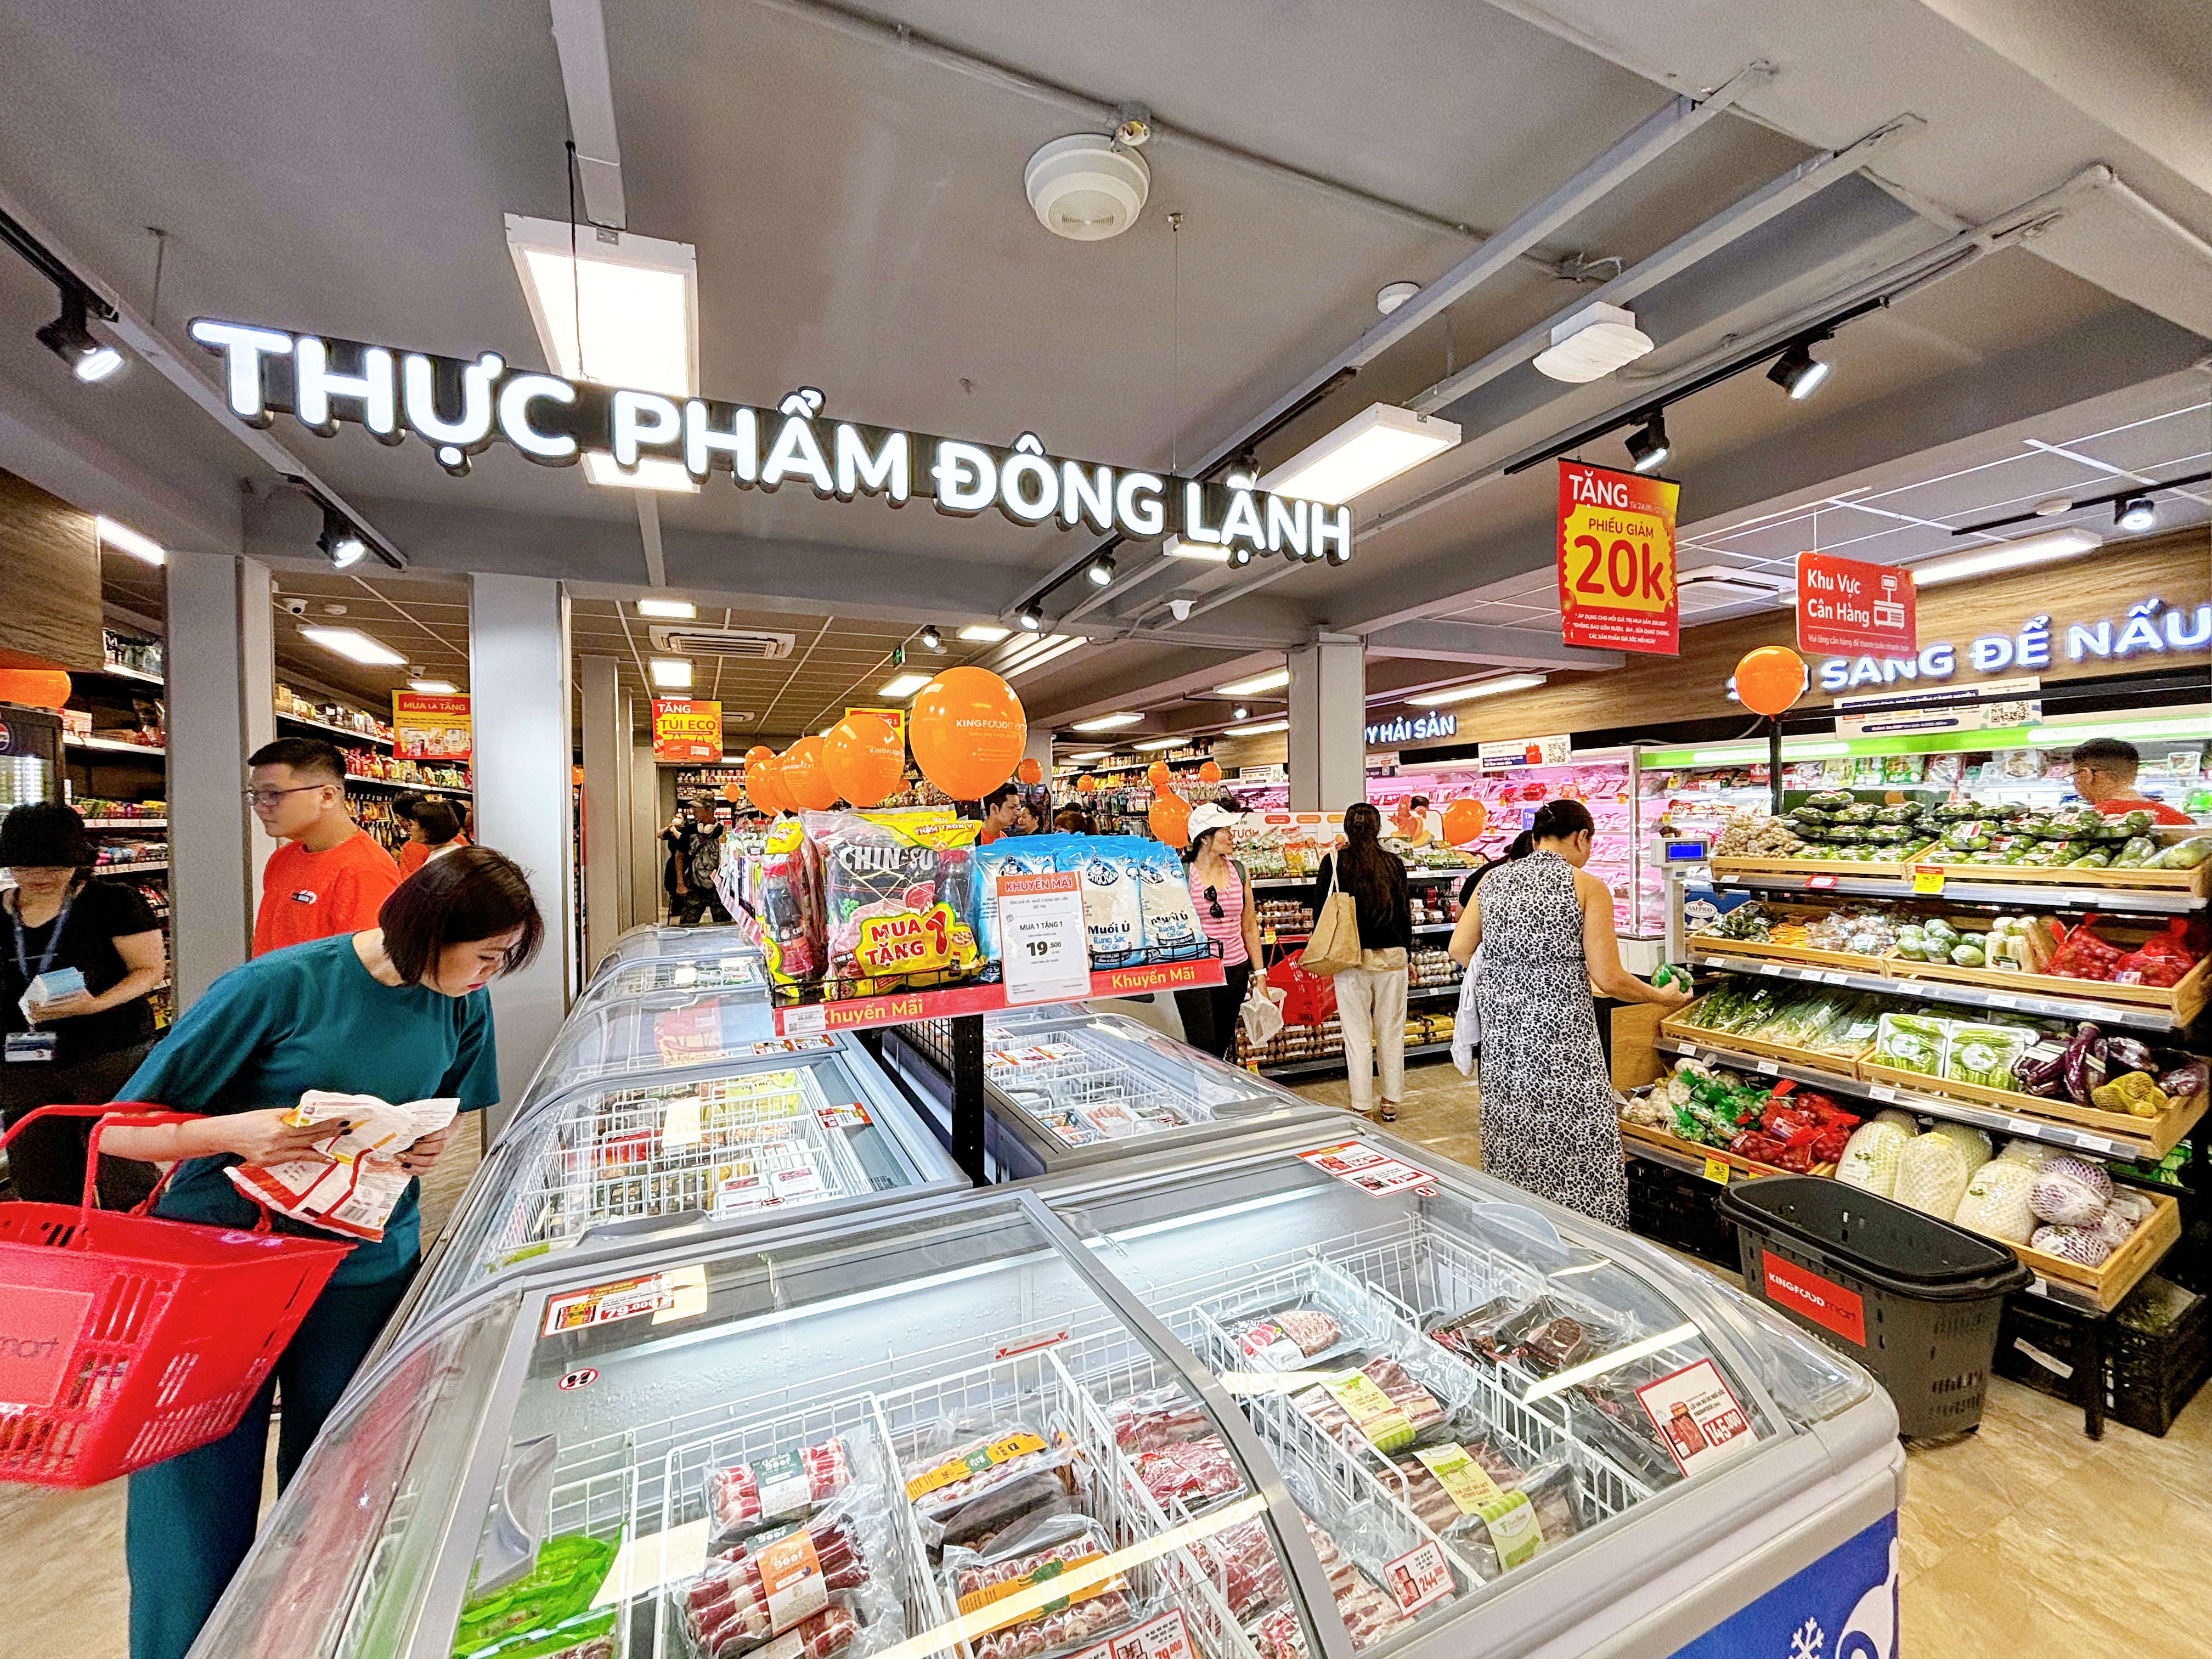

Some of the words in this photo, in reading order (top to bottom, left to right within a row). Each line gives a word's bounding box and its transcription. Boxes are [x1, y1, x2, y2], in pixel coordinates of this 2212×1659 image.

[188, 319, 578, 472] THỰC
[610, 387, 911, 502] PHẨM
[930, 432, 1165, 537] ĐÔNG
[1185, 481, 1351, 565] LẠNH
[1568, 469, 1628, 509] TẶNG
[1589, 516, 1623, 534] PHIẾU
[1627, 522, 1654, 538] GIẢM
[1573, 533, 1666, 601] 20k
[1808, 568, 1834, 591] Khu
[1837, 573, 1861, 598] Vực
[1808, 598, 1833, 619] Cân
[1836, 602, 1870, 628] Hàng
[1969, 614, 2051, 671] ĐỂ
[2068, 597, 2212, 659] NẤU
[659, 716, 683, 730] TÚI
[688, 720, 716, 730] ECO
[1380, 715, 1412, 743] HẢI
[1414, 710, 1455, 739] SẢN
[839, 847, 934, 871] CHIN-SU
[1005, 876, 1049, 892] KHUYẾN
[1051, 875, 1073, 889] MÃI
[870, 918, 922, 943] MUA
[924, 910, 948, 955] 1
[1041, 921, 1058, 930] TẶNG
[1087, 921, 1119, 935] Muối
[1122, 922, 1131, 933] Ủ
[864, 939, 925, 967] TẶNG
[1111, 967, 1166, 989] Khuyến
[1169, 966, 1195, 982] Mãi
[891, 998, 923, 1017] Mãi
